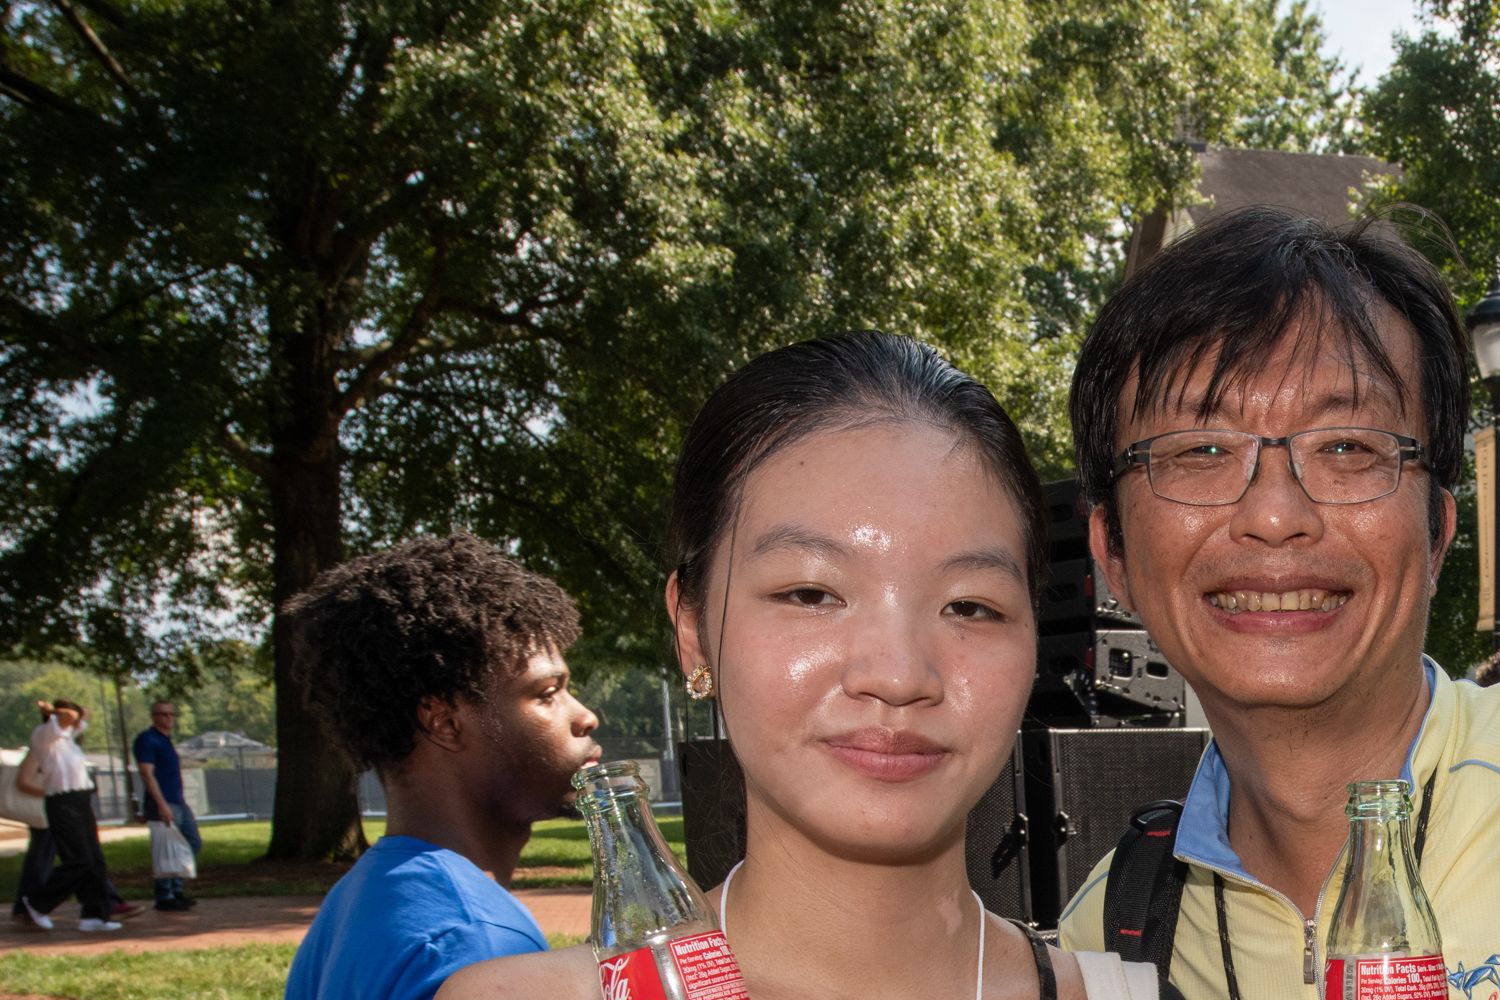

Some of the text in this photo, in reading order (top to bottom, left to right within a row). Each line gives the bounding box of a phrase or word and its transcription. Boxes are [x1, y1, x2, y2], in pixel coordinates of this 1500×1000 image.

[674, 940, 709, 956] Nutrition
[1361, 965, 1394, 975] Nutritn
[1396, 963, 1416, 974] Facts
